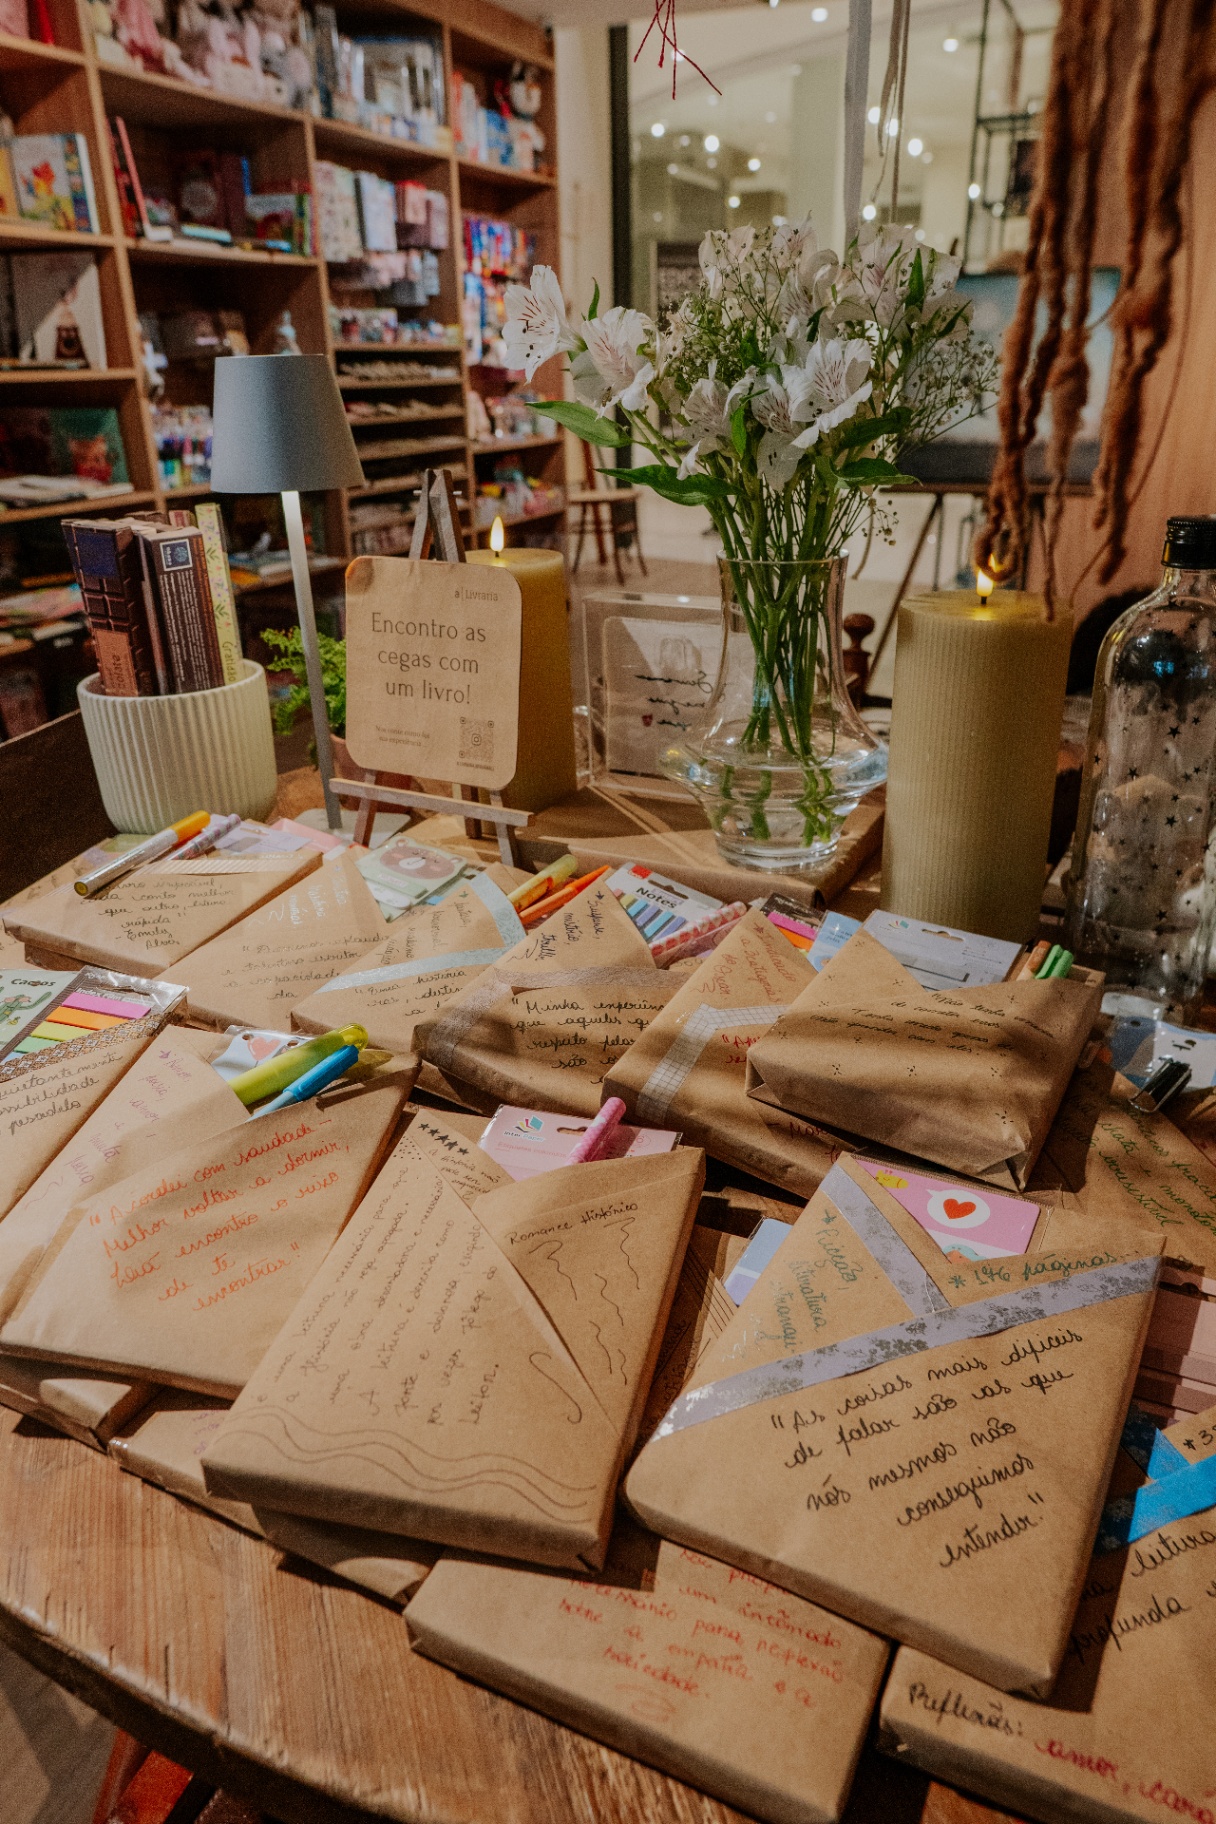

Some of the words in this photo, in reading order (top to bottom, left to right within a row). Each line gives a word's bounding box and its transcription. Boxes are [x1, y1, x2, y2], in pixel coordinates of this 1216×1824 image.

[371, 612, 458, 640] Encontro
[377, 649, 432, 673] cegas
[439, 654, 479, 674] com
[385, 681, 414, 698] um
[422, 679, 471, 705] livro!
[636, 887, 677, 909] Notes
[193, 1162, 227, 1183] com
[233, 1127, 316, 1168] saudade
[102, 1217, 169, 1258] Melhor
[183, 1187, 246, 1221] voltar
[249, 1177, 272, 1190] a
[175, 1211, 260, 1259] encontro
[509, 1222, 574, 1245] Romance
[158, 1279, 194, 1302] de
[211, 1252, 236, 1277] te
[837, 1375, 913, 1417] coisas
[927, 1355, 989, 1381] mais
[784, 1441, 824, 1469] de
[836, 1418, 901, 1456] falar
[912, 1393, 958, 1422] são
[971, 1378, 1012, 1402] as
[1020, 1369, 1075, 1394] que
[806, 1474, 852, 1511] nós
[868, 1441, 958, 1491] mesmos
[970, 1416, 1017, 1449] não
[897, 1453, 1035, 1527] conseguimos
[692, 1618, 746, 1646] para
